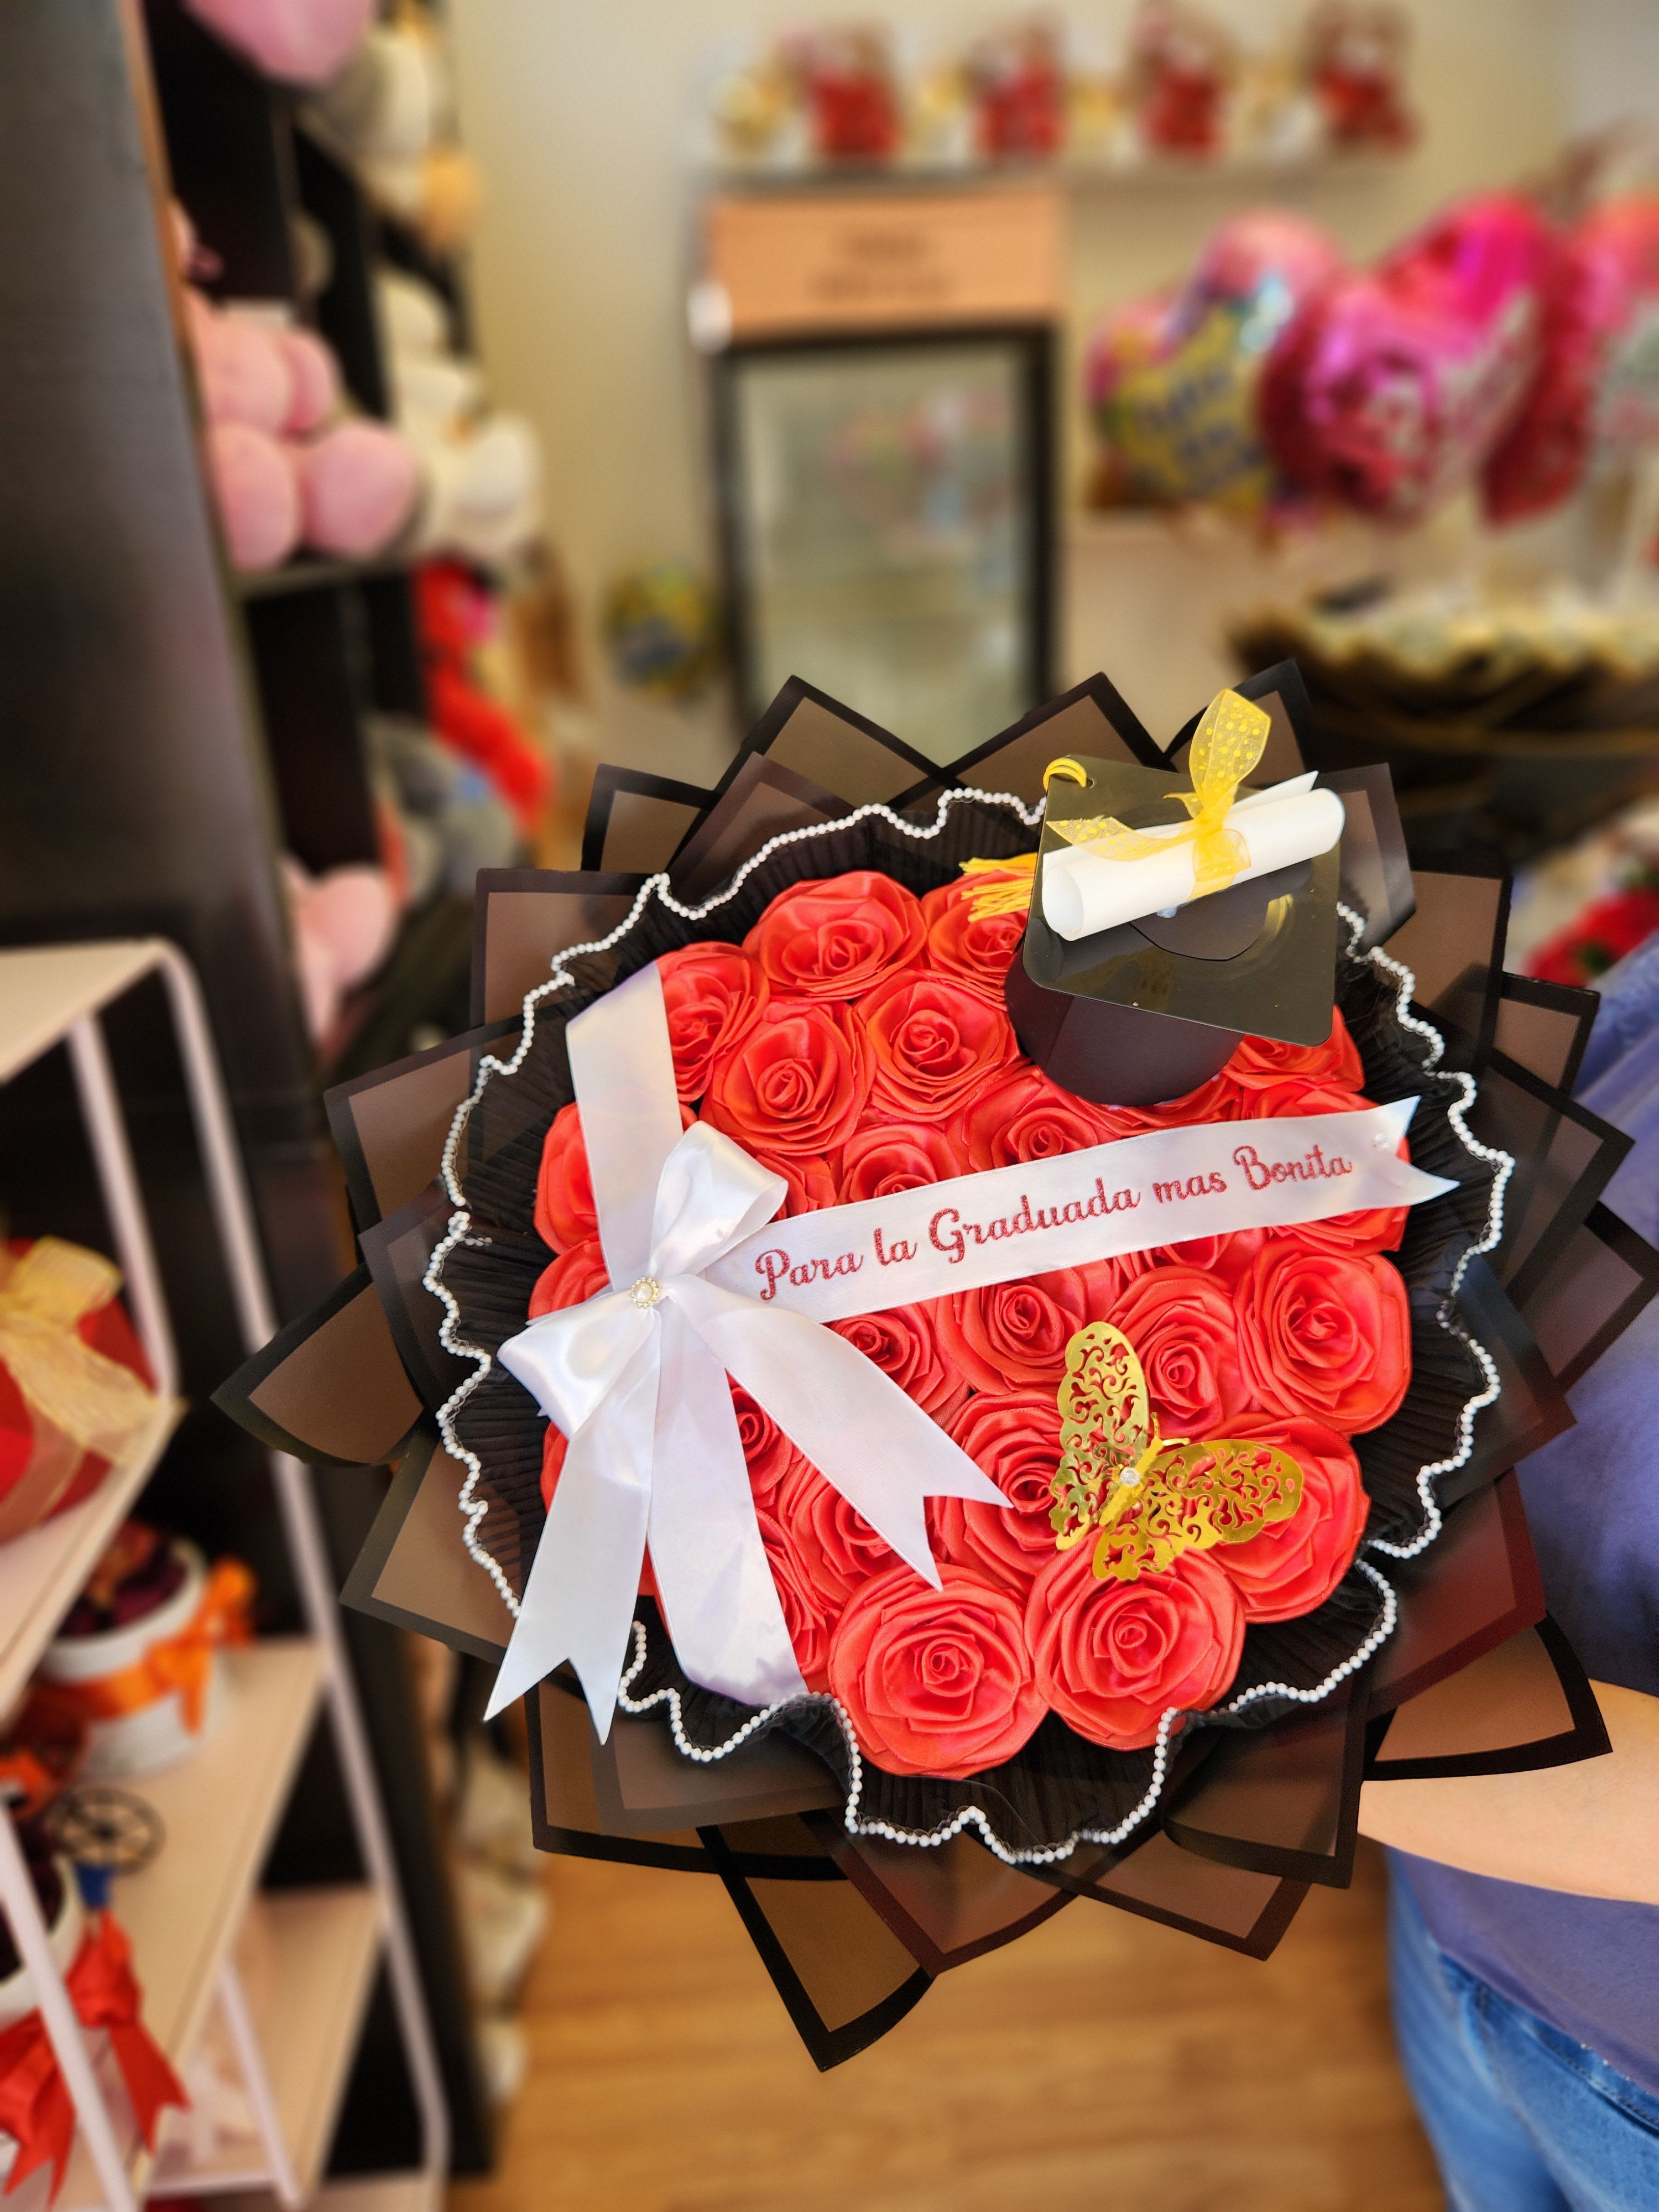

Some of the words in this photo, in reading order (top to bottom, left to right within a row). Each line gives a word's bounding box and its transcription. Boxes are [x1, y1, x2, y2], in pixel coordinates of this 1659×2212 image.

[754, 1249, 864, 1301] Para
[873, 1228, 918, 1266] la
[928, 1177, 1141, 1264] Graduada
[1152, 1171, 1228, 1204] mas
[1232, 1144, 1353, 1191] Bonita
